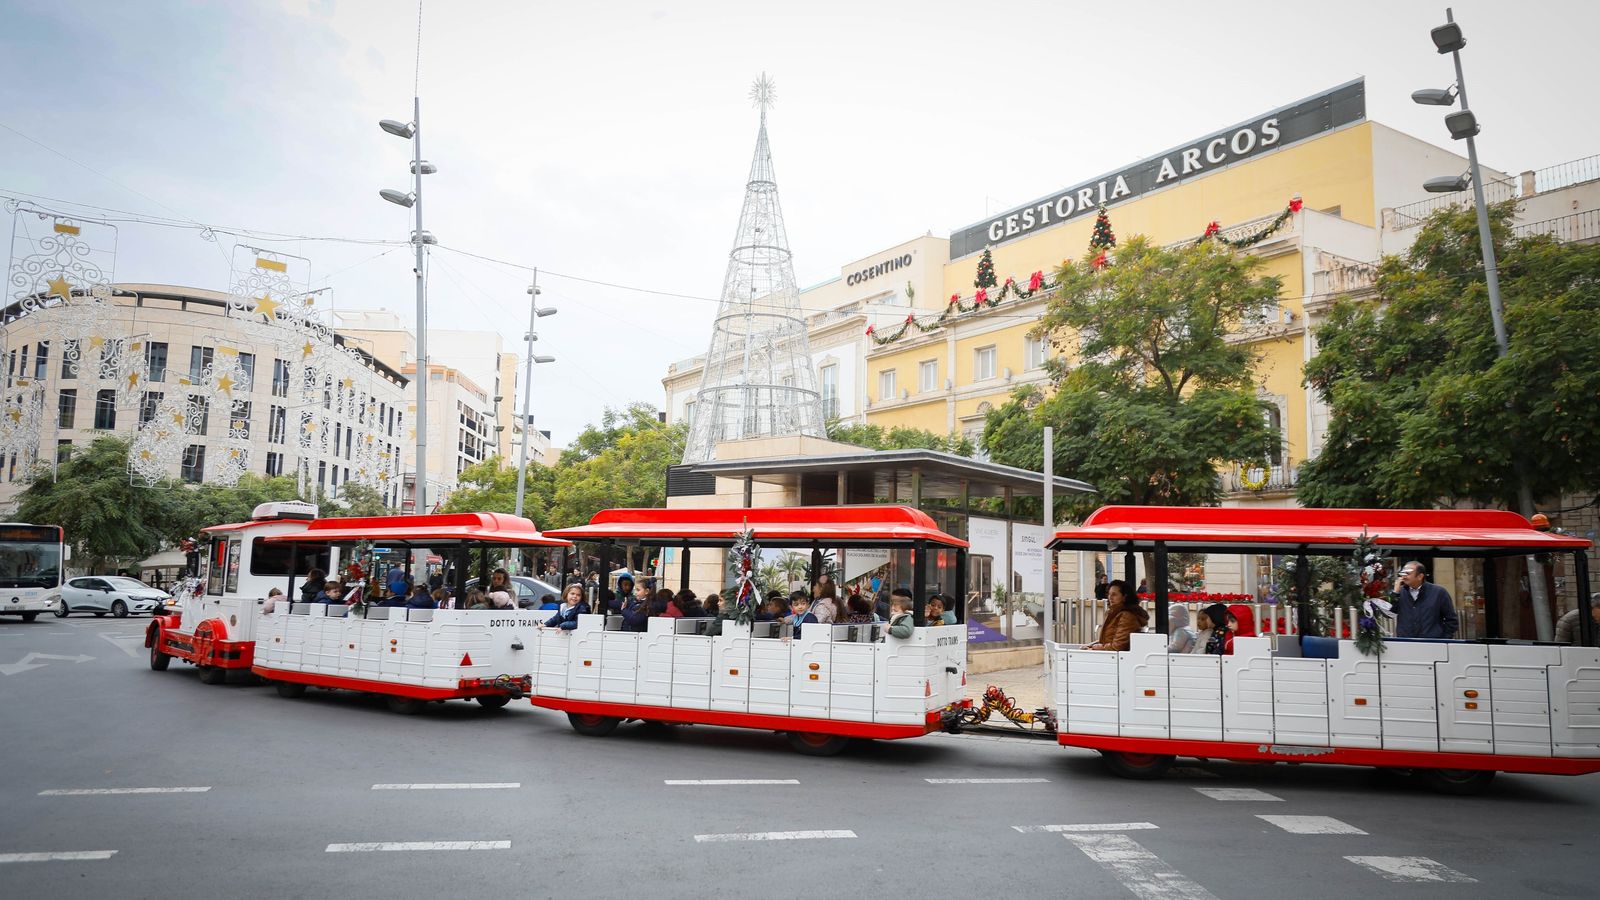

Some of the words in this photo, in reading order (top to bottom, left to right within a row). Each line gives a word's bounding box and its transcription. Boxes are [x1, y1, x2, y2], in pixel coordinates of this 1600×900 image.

[988, 174, 1131, 242] GESTORIA
[1155, 117, 1280, 184] ARCOS
[846, 253, 912, 287] COSENTINO
[490, 619, 515, 627] DOTTO
